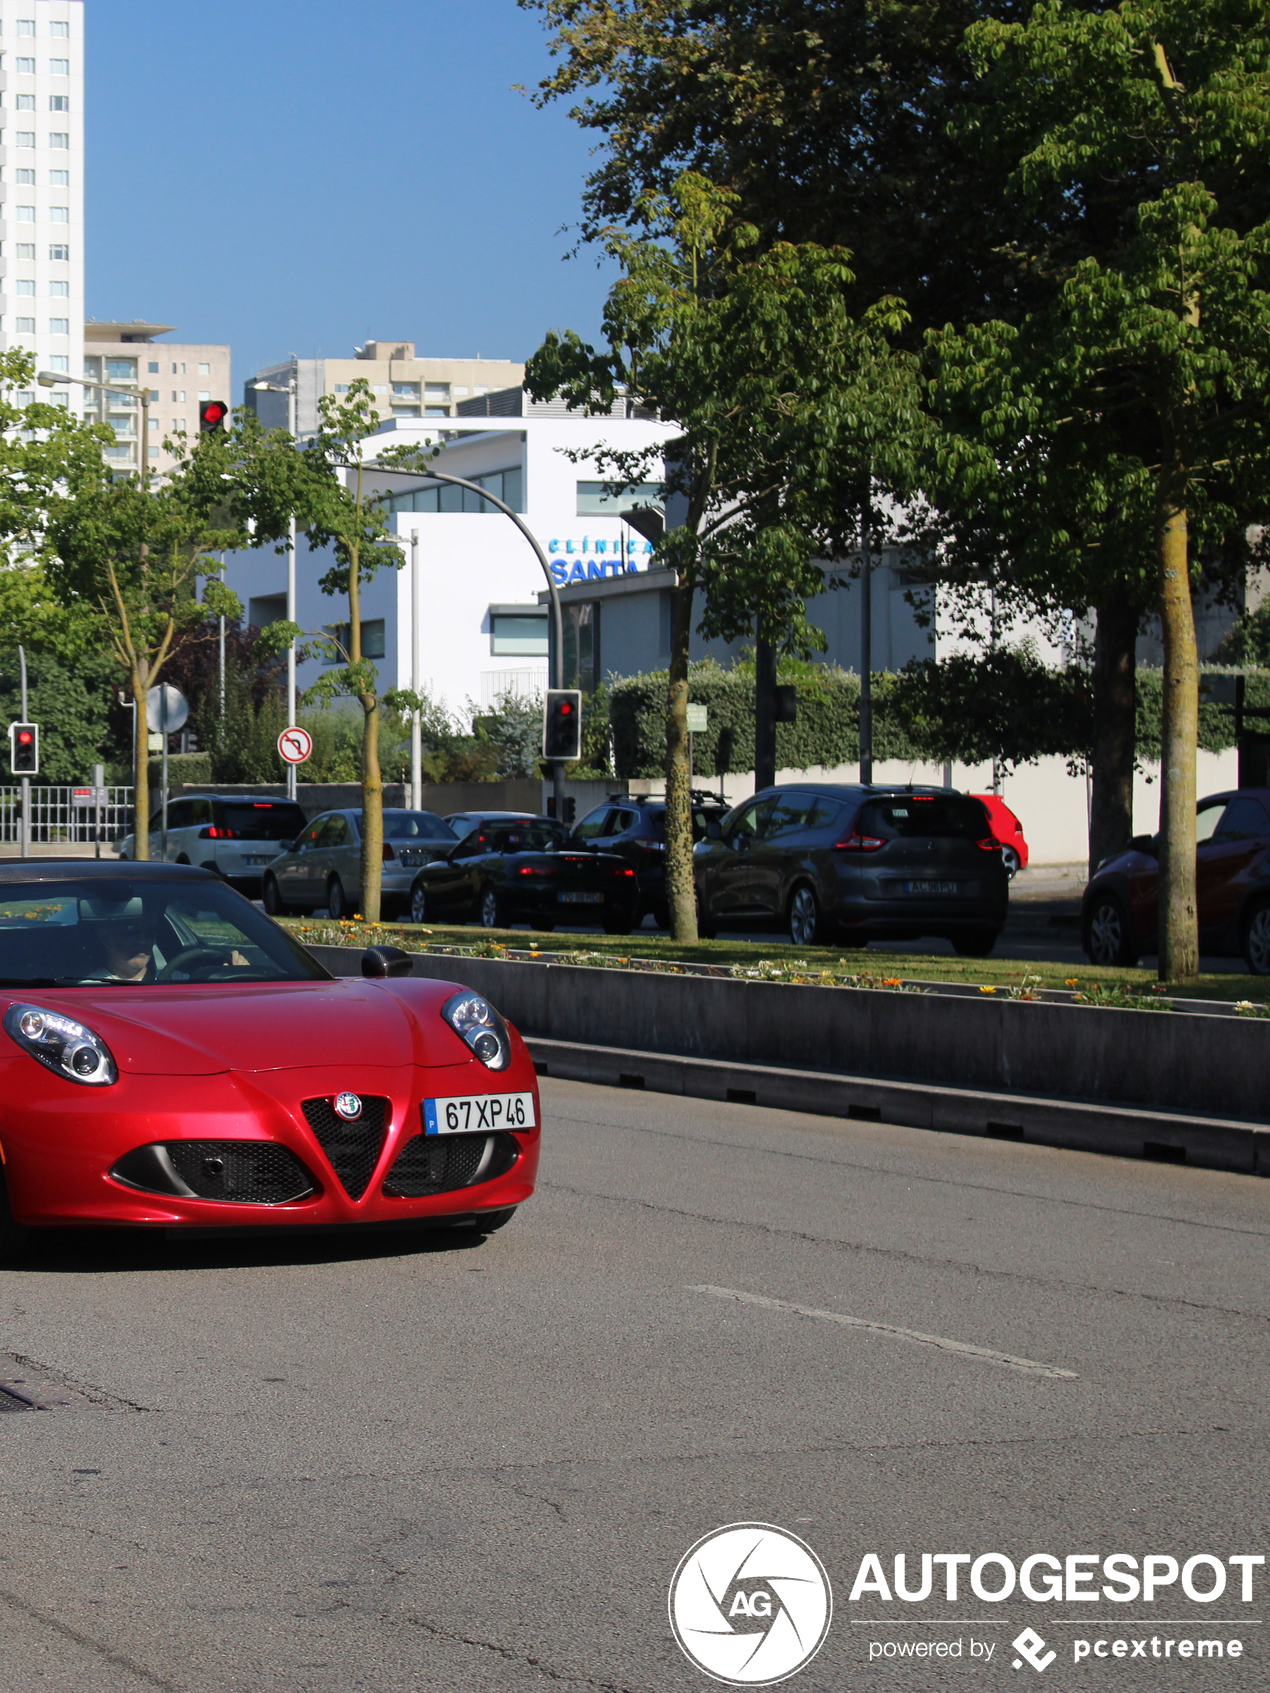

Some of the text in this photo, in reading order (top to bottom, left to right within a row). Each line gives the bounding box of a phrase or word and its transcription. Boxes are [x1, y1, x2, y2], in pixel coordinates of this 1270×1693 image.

[549, 535, 655, 554] CLÍNICA
[549, 559, 638, 583] SANTA
[429, 1120, 435, 1129] P
